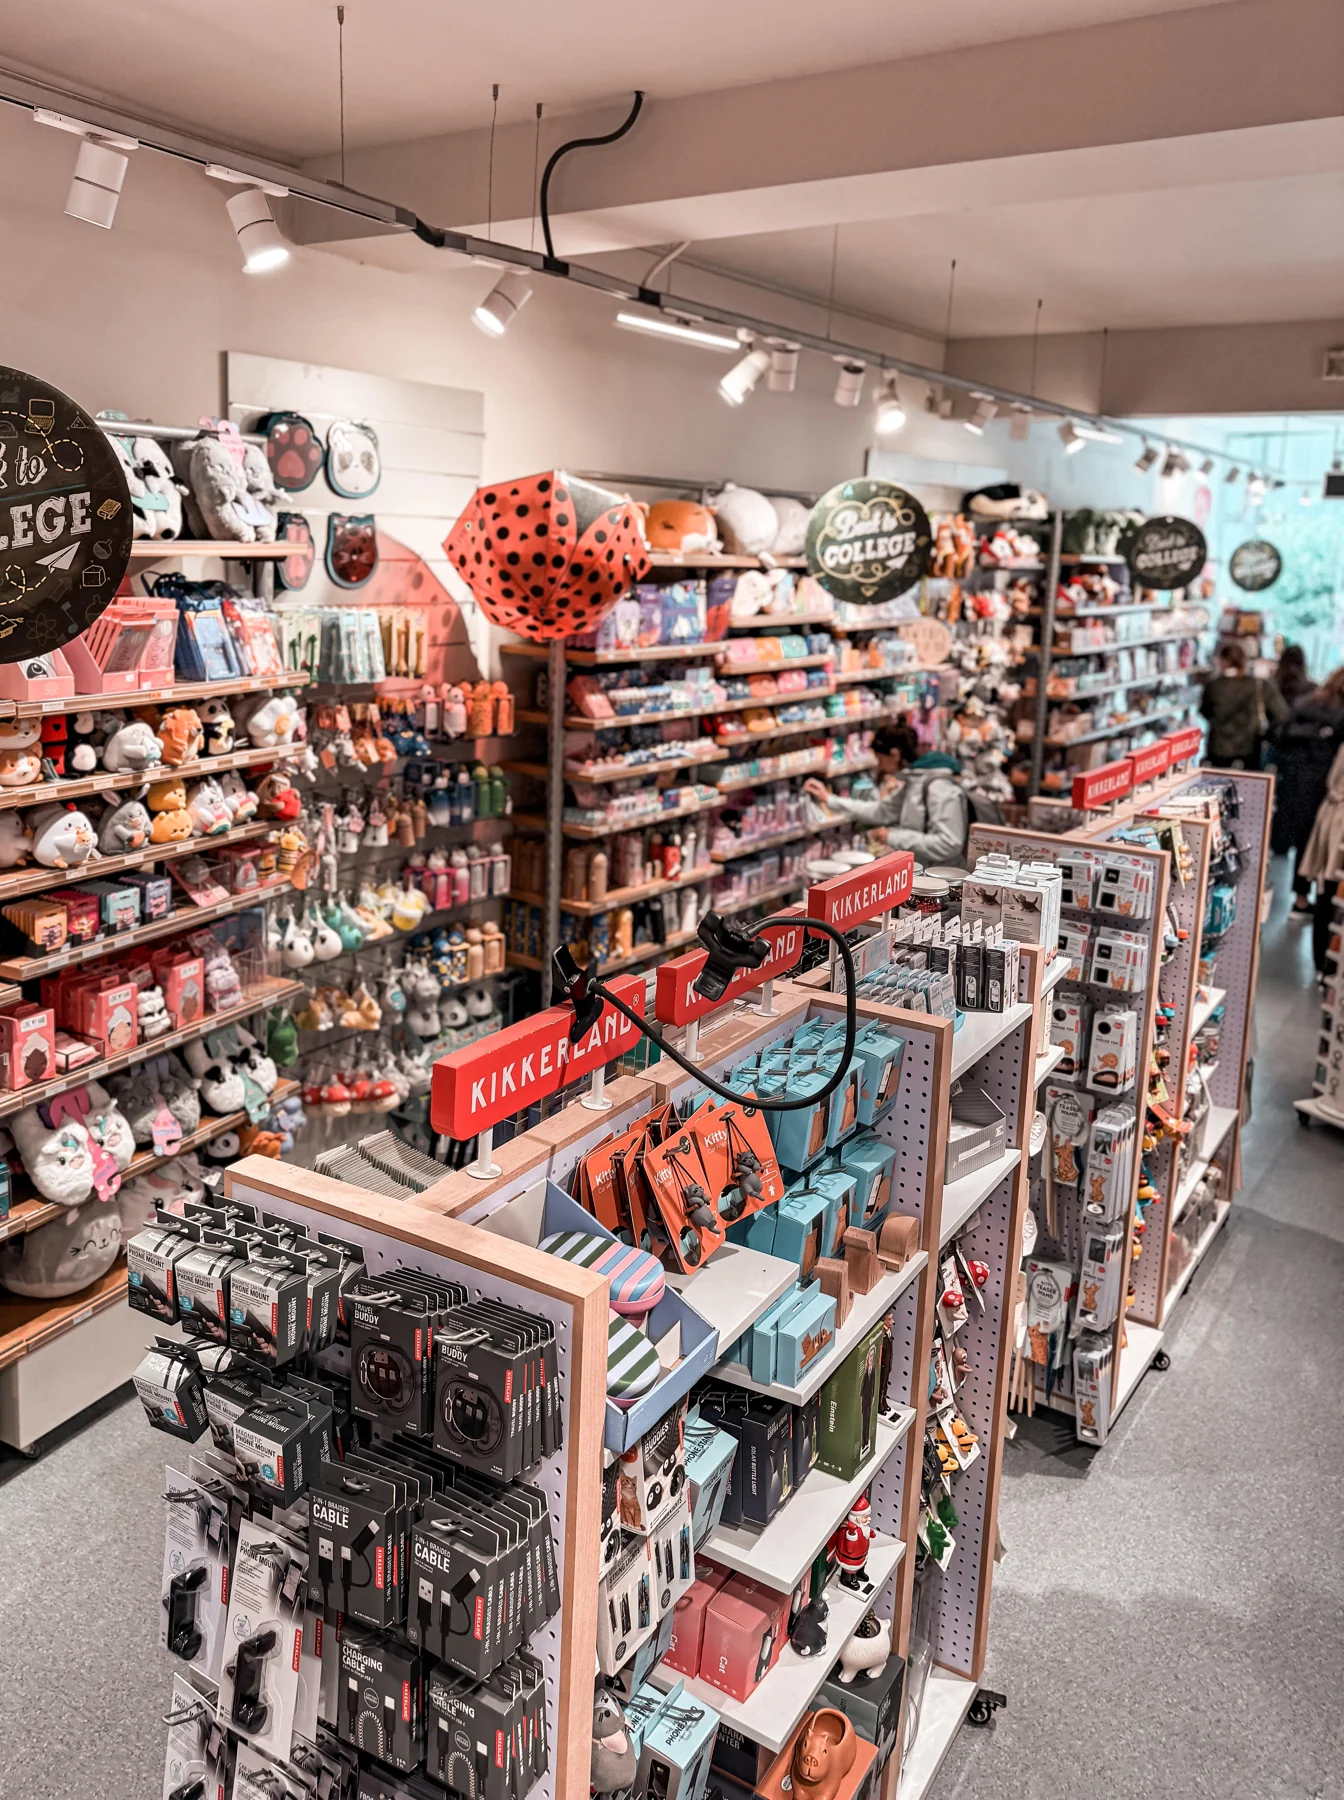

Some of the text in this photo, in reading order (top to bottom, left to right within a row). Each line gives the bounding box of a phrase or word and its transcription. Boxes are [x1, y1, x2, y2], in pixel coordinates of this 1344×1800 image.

[15, 446, 48, 485] to
[824, 532, 916, 567] COLLEGE
[1088, 772, 1129, 799] KIKKERLAND
[704, 1129, 728, 1148] Kitty
[654, 1166, 673, 1186] Kitty
[129, 1249, 164, 1268] PHONE MOUNT
[177, 1273, 214, 1289] PHONE MOUNT
[1036, 1284, 1056, 1295] TEASER
[232, 1283, 269, 1302] PHONE MOUNT
[1037, 1290, 1053, 1299] WAND
[354, 1303, 374, 1315] TRAVEL
[354, 1311, 380, 1325] BUDDY
[441, 1345, 468, 1362] BUDDY
[154, 1391, 172, 1402] MOUNT
[233, 1386, 254, 1397] MOUNT
[207, 1400, 222, 1414] PHONE
[253, 1409, 281, 1422] MAGNETIC
[829, 1400, 837, 1432] Einstein
[248, 1413, 290, 1433] PHONE MOUNT
[235, 1428, 262, 1444] MAGNETIC
[644, 1422, 669, 1453] BUDDIES
[236, 1435, 276, 1457] PHONE MOUNT
[685, 1444, 701, 1466] PHONE
[313, 1496, 349, 1513] 2-IN-1 BRAIDED
[313, 1504, 349, 1529] CABLE
[241, 1539, 250, 1548] CAR
[415, 1535, 450, 1558] 2-IN-1 BRAIDED
[240, 1546, 258, 1562] PHONE
[414, 1544, 450, 1573] CABLE
[610, 1564, 625, 1583] STRING
[625, 1549, 640, 1569] LIGHTS
[745, 1583, 757, 1594] Cat
[669, 1634, 678, 1652] Cat
[343, 1646, 383, 1672] CHARGING
[343, 1655, 366, 1674] CABLE
[719, 1656, 728, 1674] Cat
[433, 1698, 457, 1716] CABLE
[666, 1723, 683, 1746] PHONE
